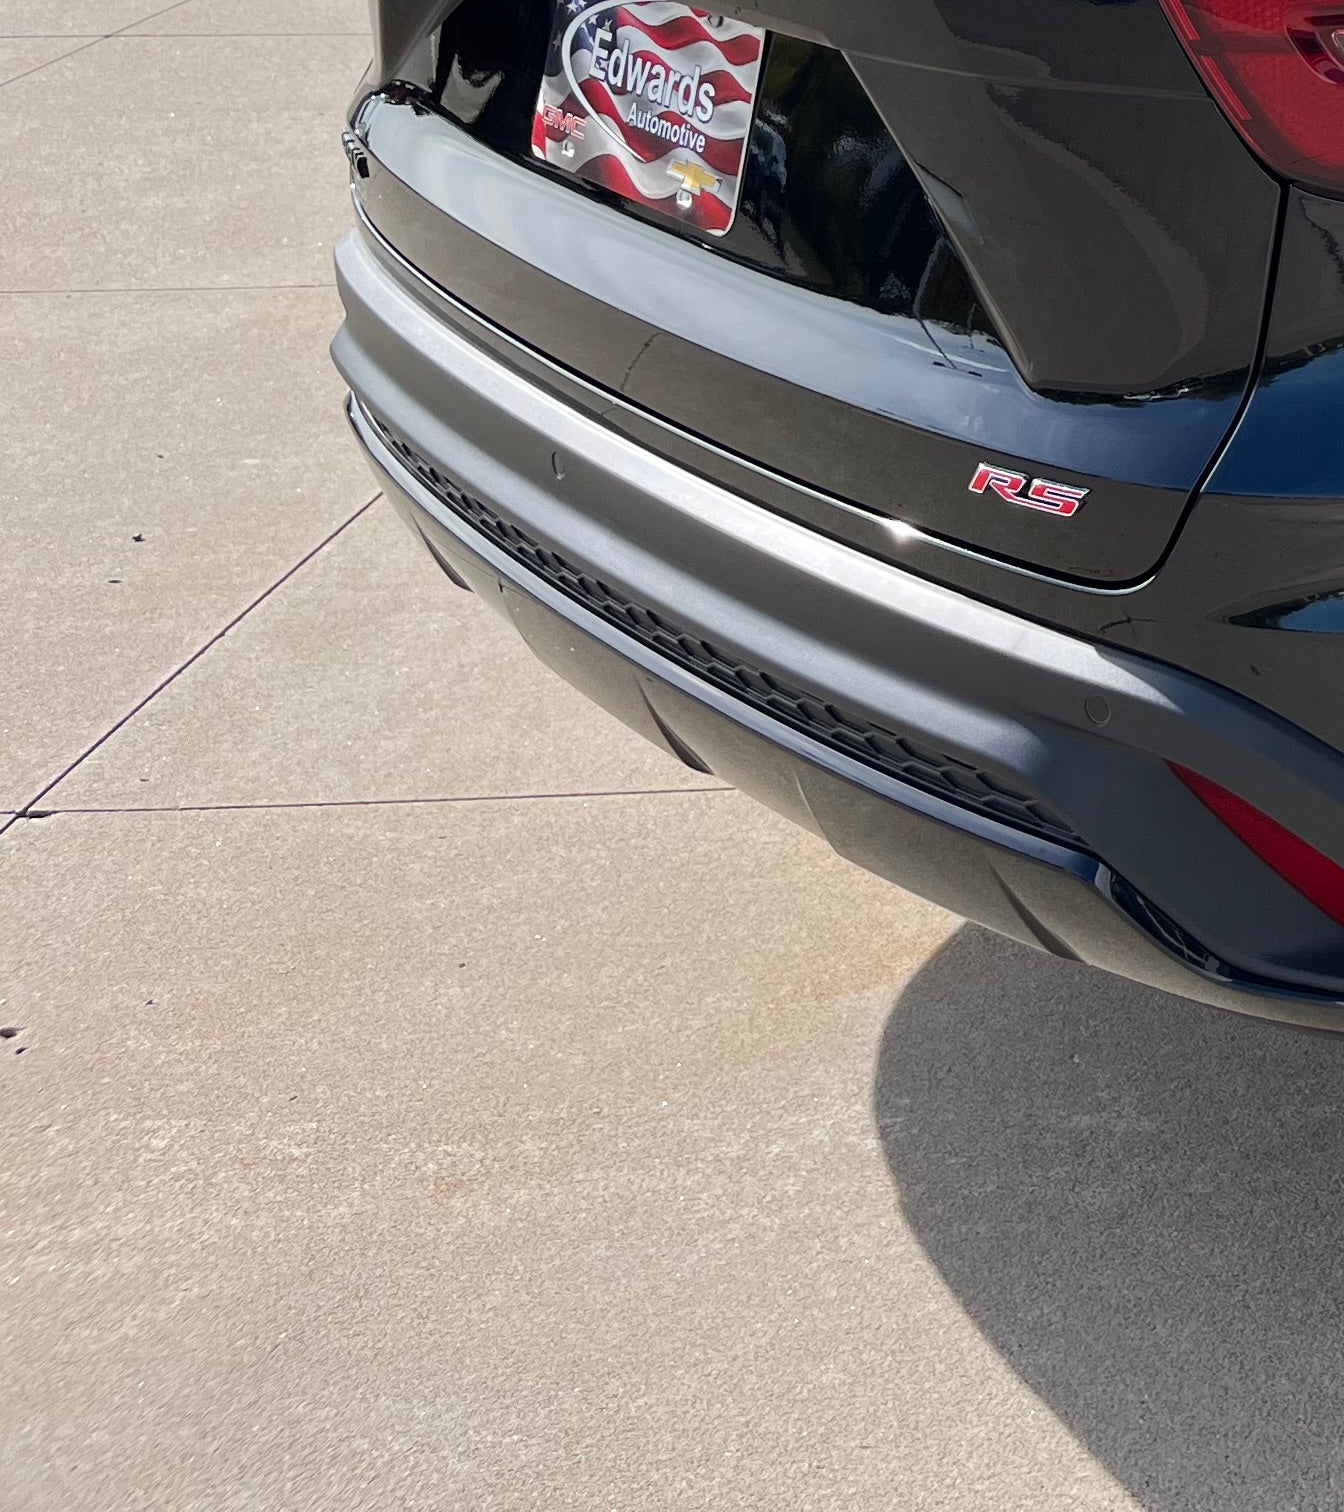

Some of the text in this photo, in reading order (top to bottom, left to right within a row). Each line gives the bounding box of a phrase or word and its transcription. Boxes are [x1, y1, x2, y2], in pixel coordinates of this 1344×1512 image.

[588, 28, 716, 123] Edwards
[541, 103, 587, 141] GMC
[625, 102, 706, 153] Automotive
[968, 461, 1091, 518] RS
